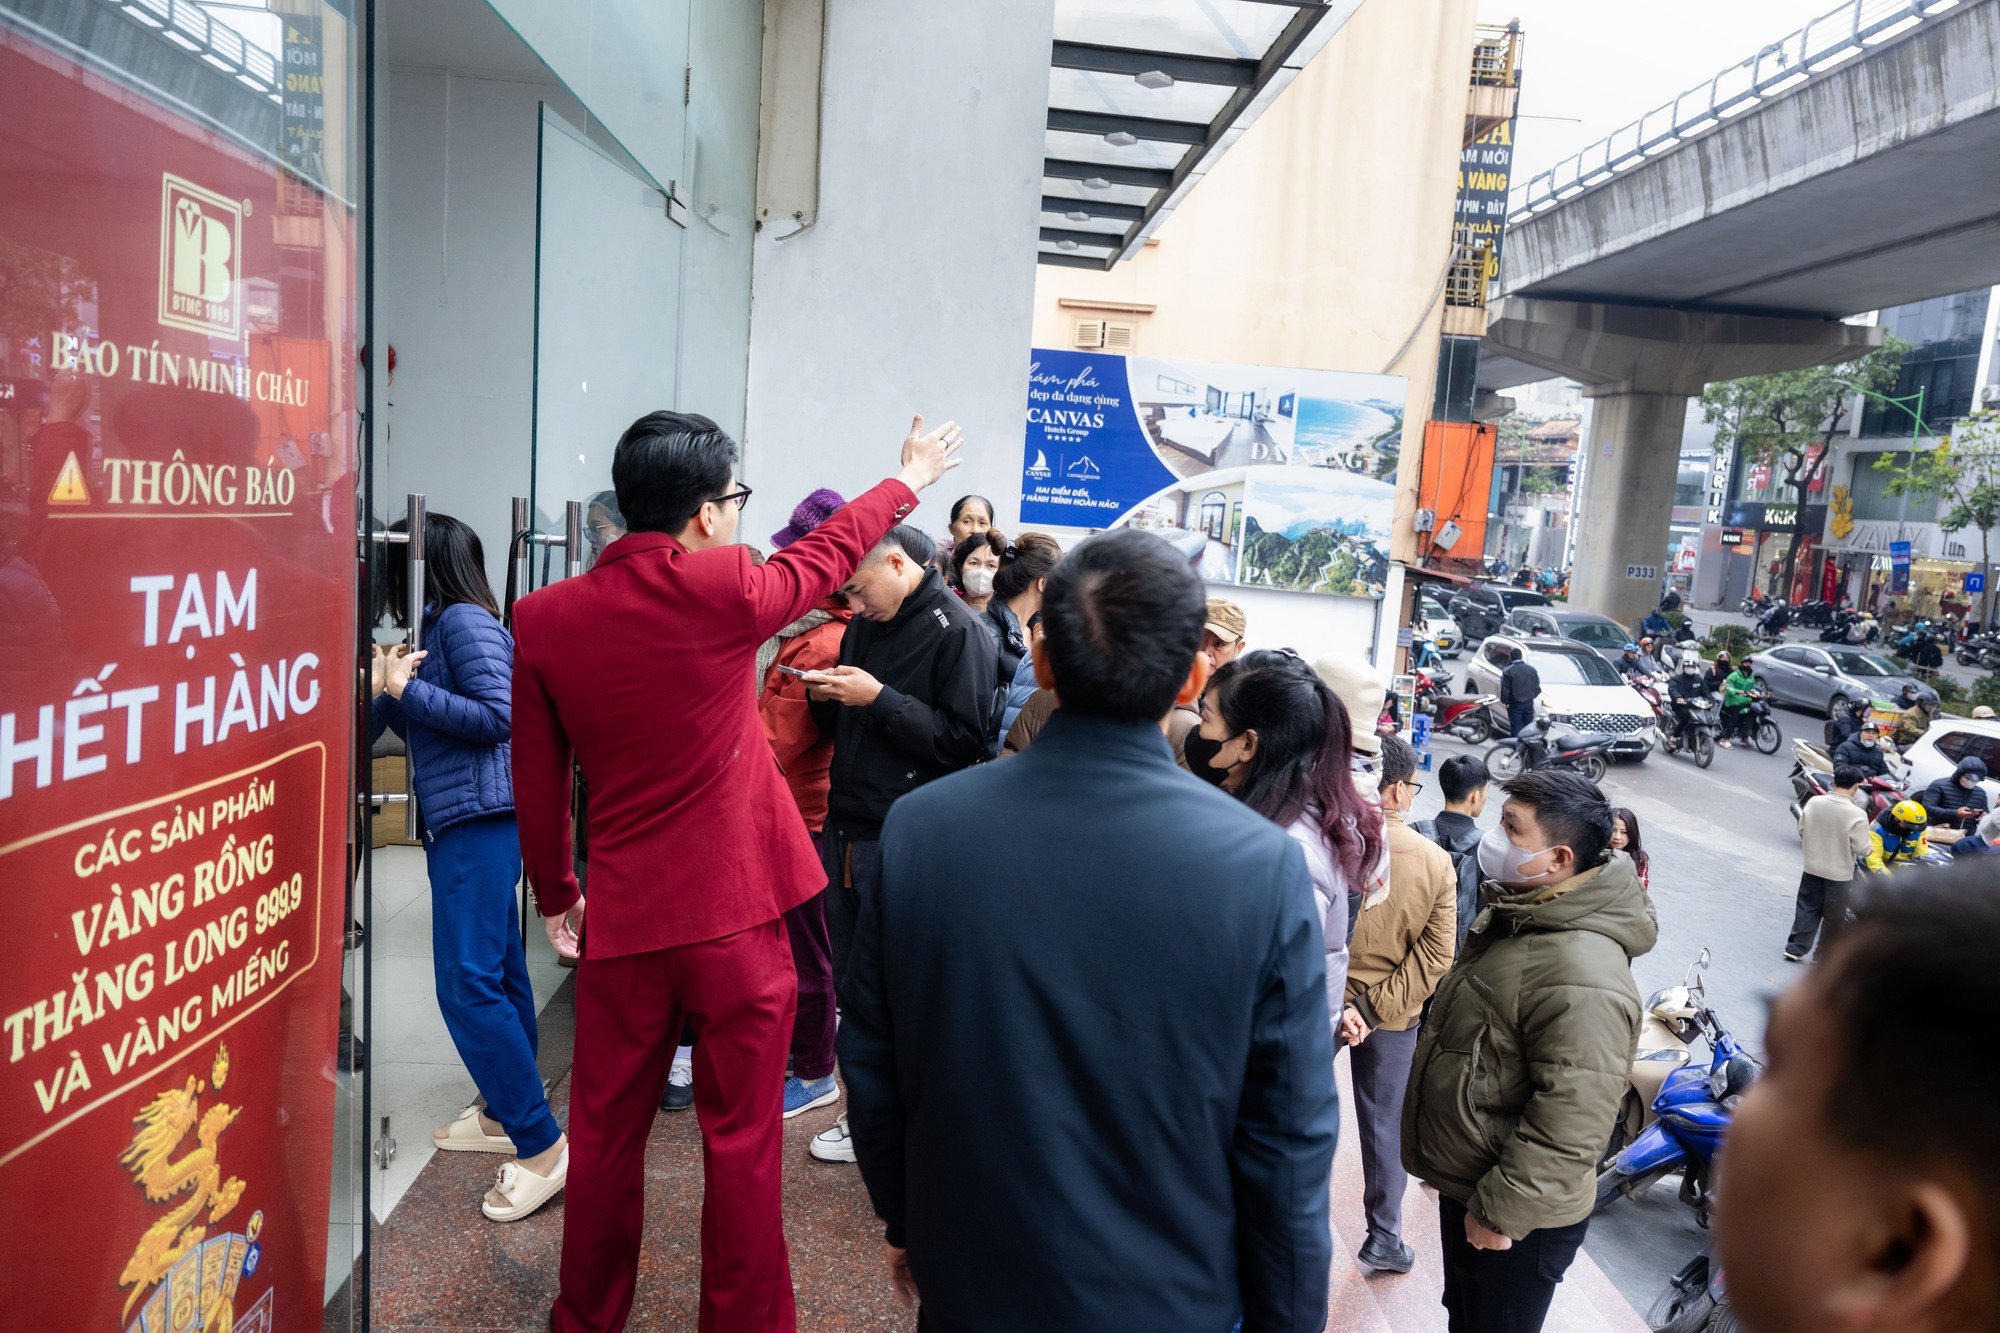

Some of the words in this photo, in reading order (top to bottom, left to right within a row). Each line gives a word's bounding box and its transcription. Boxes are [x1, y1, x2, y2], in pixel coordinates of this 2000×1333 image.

[1482, 147, 1509, 165] MỚI
[1468, 168, 1508, 192] VÀNG
[1464, 200, 1479, 214] PIN
[1487, 199, 1506, 215] DÂY
[173, 293, 202, 317] BTMC
[205, 303, 230, 323] 1989
[50, 325, 120, 378] BẢO
[126, 341, 180, 387] TÍN
[187, 356, 251, 401] MINH
[256, 369, 309, 408] CHÂU
[1064, 366, 1100, 393] phá
[1027, 408, 1104, 429] CANVAS
[1044, 425, 1066, 434] Hotels
[1067, 428, 1089, 437] Group
[103, 449, 239, 506] THÔNG
[246, 456, 295, 506] BÁO
[1035, 486, 1049, 495] HAI
[1707, 456, 1727, 524] KRIK
[1027, 494, 1049, 503] HÀNH
[1244, 566, 1274, 586] PA
[1627, 566, 1655, 579] P333
[130, 568, 257, 660] TẠM
[0, 663, 159, 799] HẾT
[174, 652, 320, 755] HÀNG
[74, 829, 142, 878] CÁC
[150, 805, 204, 853] SẢN
[212, 777, 275, 830] PHẨM
[71, 873, 184, 957] VÀNG
[193, 833, 273, 908] RỒNG
[3, 953, 154, 1064] THĂNG
[164, 906, 248, 986] LONG
[34, 1051, 91, 1114] VÀ
[102, 995, 203, 1076] VÀNG
[211, 939, 290, 1019] MIẾNG
